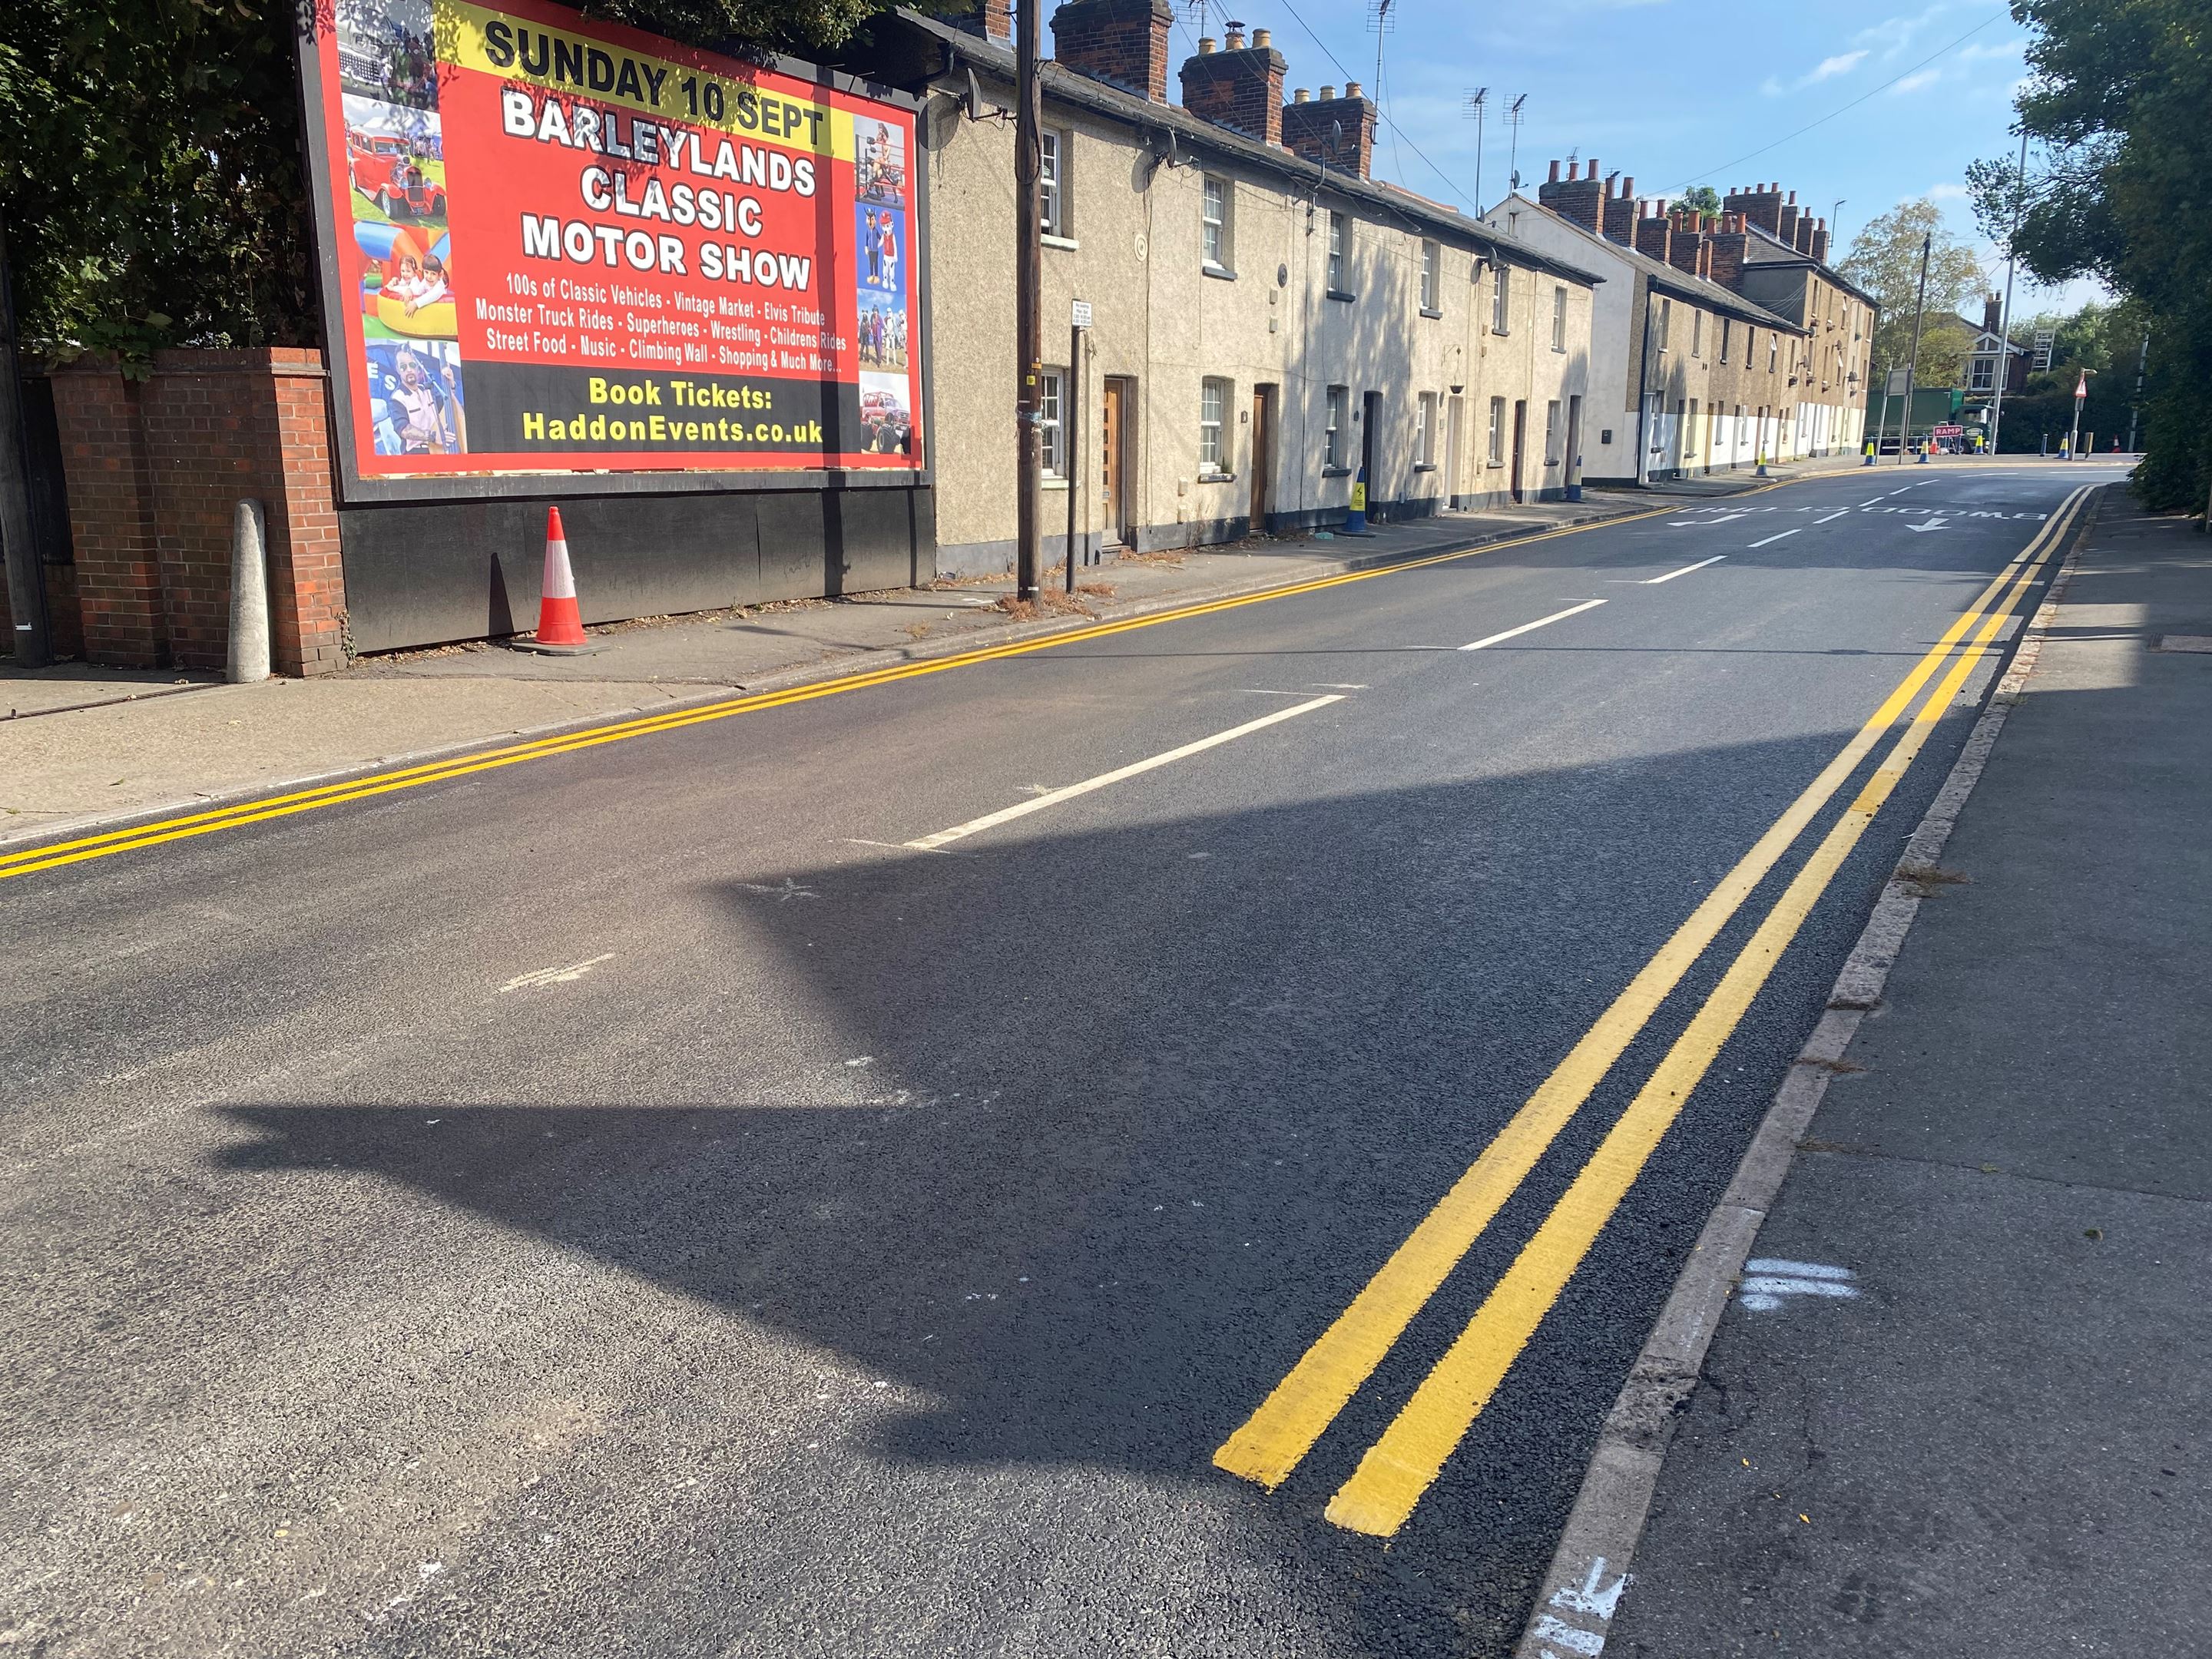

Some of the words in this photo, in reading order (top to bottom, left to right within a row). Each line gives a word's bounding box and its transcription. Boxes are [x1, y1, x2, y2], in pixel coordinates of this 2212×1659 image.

[485, 21, 667, 106] SUNDAY
[681, 77, 724, 121] 10
[737, 91, 823, 145] SEPT
[501, 86, 816, 197] BARLEYLANDS
[580, 165, 763, 238] CLASSIC
[521, 212, 688, 276] MOTOR
[699, 240, 811, 292] SHOW
[475, 297, 533, 324] Monster
[537, 303, 575, 327] Truck
[579, 308, 614, 330] Rides
[627, 313, 700, 337] Superheroes
[710, 320, 760, 346] Wrestling
[770, 326, 817, 348] Childrens
[820, 332, 846, 350] Rides
[506, 272, 538, 296] 100s
[542, 277, 556, 298] of
[560, 278, 607, 304] Classic
[611, 284, 662, 307] Vehicles
[674, 291, 715, 318] Vintage
[719, 296, 754, 318] Market
[764, 302, 788, 322] Elvis
[791, 305, 825, 326] Tribute
[487, 328, 529, 352] Street
[533, 332, 567, 354] Food
[581, 335, 616, 357] Music
[629, 338, 682, 366] Climbing
[684, 343, 707, 363] Wall
[720, 346, 768, 371] Shopping
[770, 350, 777, 368] &
[781, 351, 806, 370] Much
[810, 354, 842, 373] More...
[589, 377, 661, 406] Book
[670, 380, 772, 409] Tickets:
[522, 412, 823, 443] HaddonEvents.co.uk
[1861, 507, 2048, 521] B'WOOD
